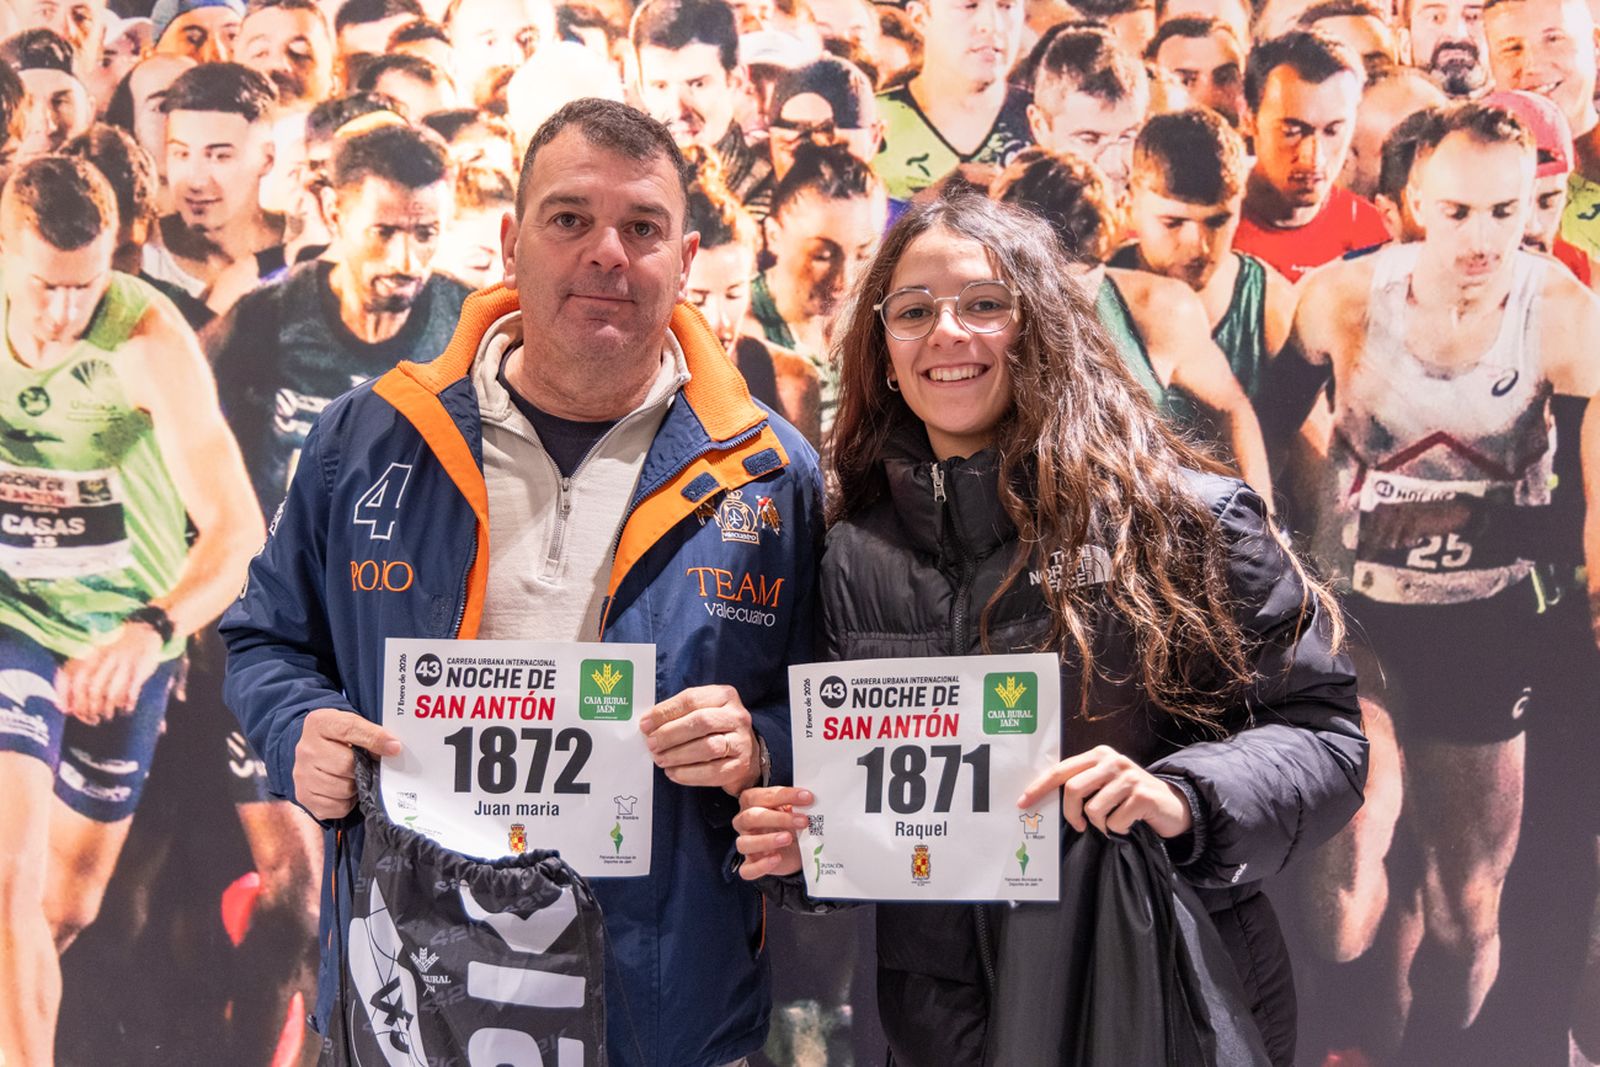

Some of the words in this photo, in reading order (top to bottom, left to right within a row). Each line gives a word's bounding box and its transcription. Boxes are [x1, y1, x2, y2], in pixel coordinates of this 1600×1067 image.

[353, 462, 413, 540] 4
[2, 513, 86, 537] CASAS
[1406, 532, 1473, 569] 25
[351, 560, 414, 592] POJO
[686, 567, 785, 608] TEAM
[415, 660, 440, 678] 43
[446, 657, 477, 665] CARRERA
[477, 658, 504, 666] URBANA
[505, 659, 556, 667] INTERNACIONAL
[398, 674, 406, 684] de
[446, 667, 523, 689] NOCHE
[527, 669, 557, 689] DE
[851, 677, 881, 686] CARRERA
[882, 677, 909, 685] URBANA
[910, 675, 960, 684] INTERNACIONAL
[820, 683, 845, 699] 43
[852, 686, 927, 708] NOCHE
[932, 685, 960, 706] DE
[415, 695, 466, 719] SAN
[470, 690, 556, 721] ANTÓN
[584, 696, 602, 705] CAJA
[603, 697, 629, 705] RURAL
[596, 704, 616, 713] JAÉN
[804, 697, 812, 707] de
[397, 707, 405, 716] 17
[987, 710, 1006, 719] CAJA
[1007, 710, 1033, 718] RURAL
[823, 716, 872, 740] SAN
[877, 707, 960, 739] ANTÓN
[806, 729, 813, 738] 17
[444, 726, 593, 794] 1872
[857, 744, 990, 814] 1871
[474, 800, 511, 816] Juan
[516, 801, 560, 816] maria
[895, 821, 948, 840] Raquel
